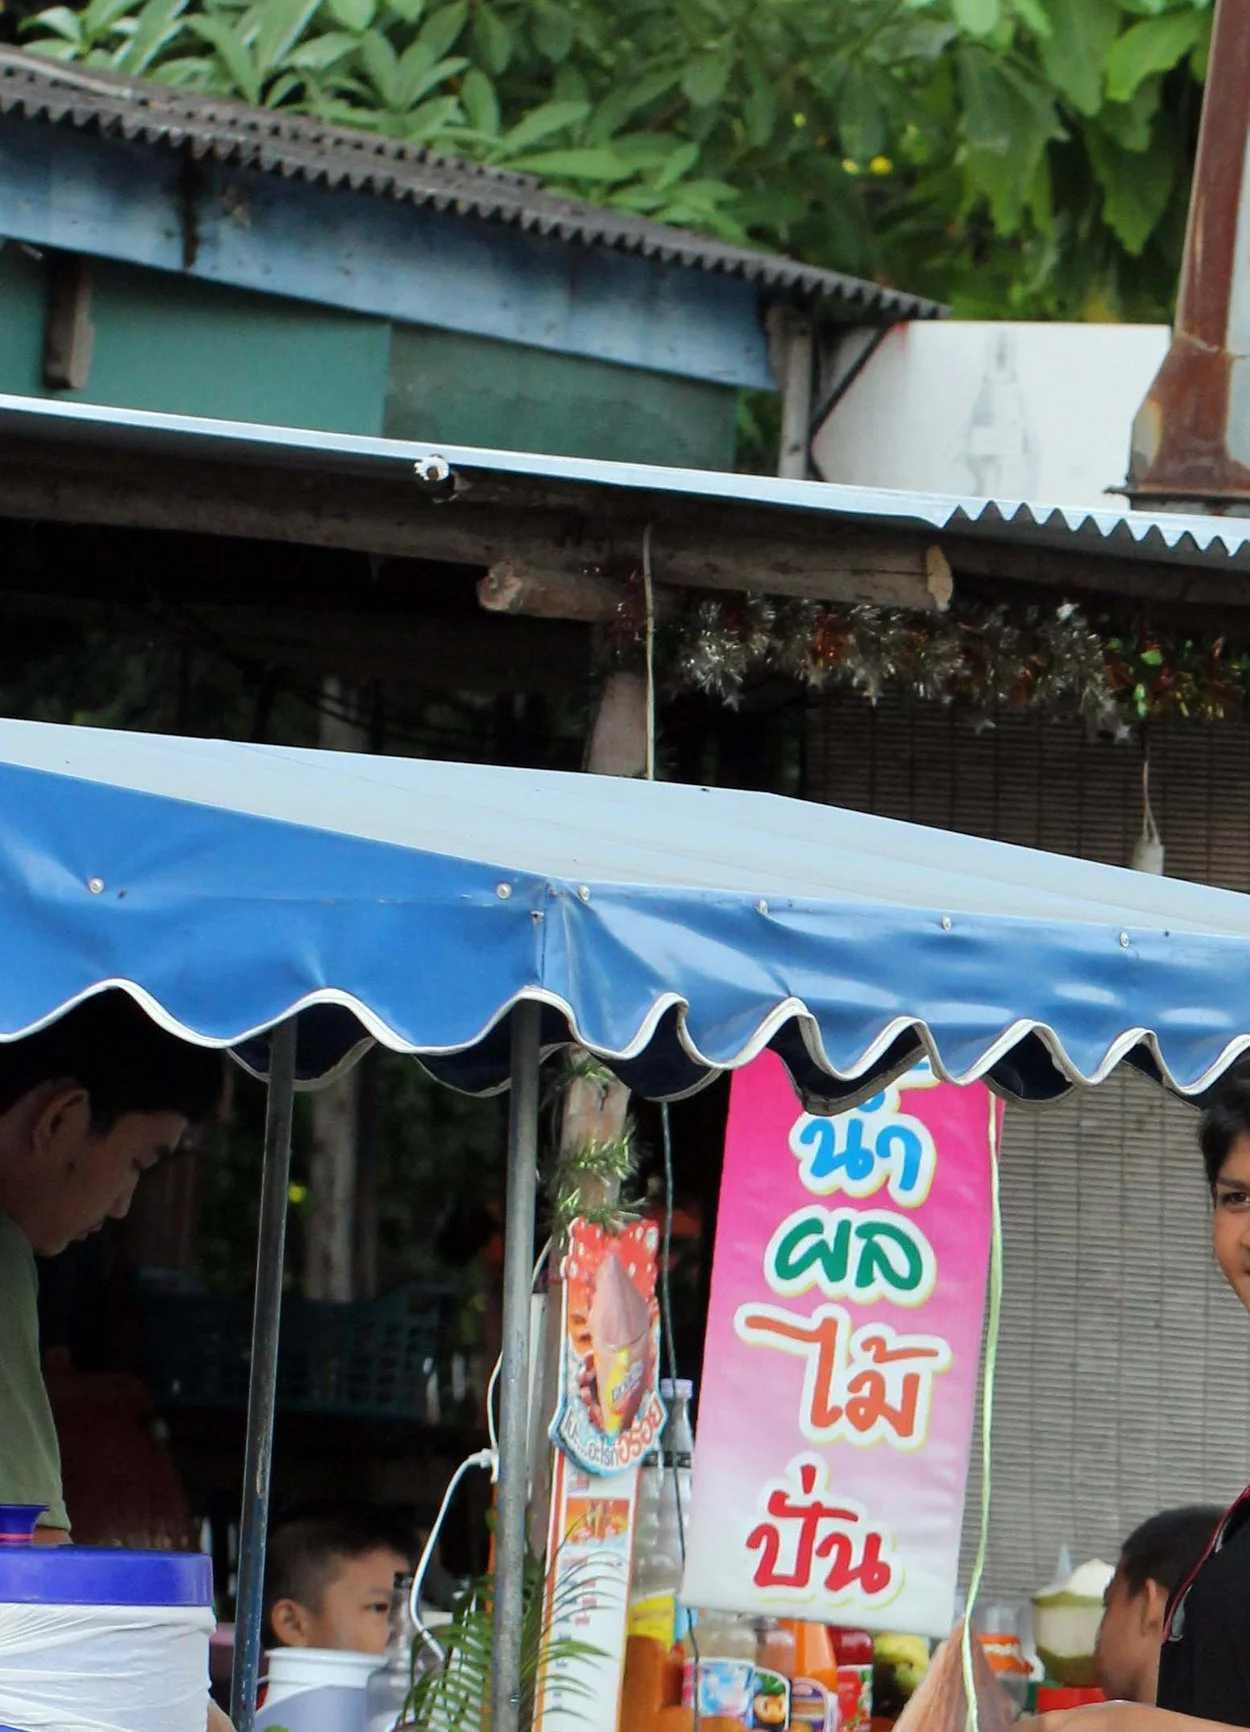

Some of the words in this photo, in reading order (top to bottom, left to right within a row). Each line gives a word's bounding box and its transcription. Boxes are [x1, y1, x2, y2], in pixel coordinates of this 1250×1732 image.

[773, 1217, 923, 1292] ผล
[743, 1316, 939, 1438] ไม้
[744, 1463, 893, 1595] ปั่น
